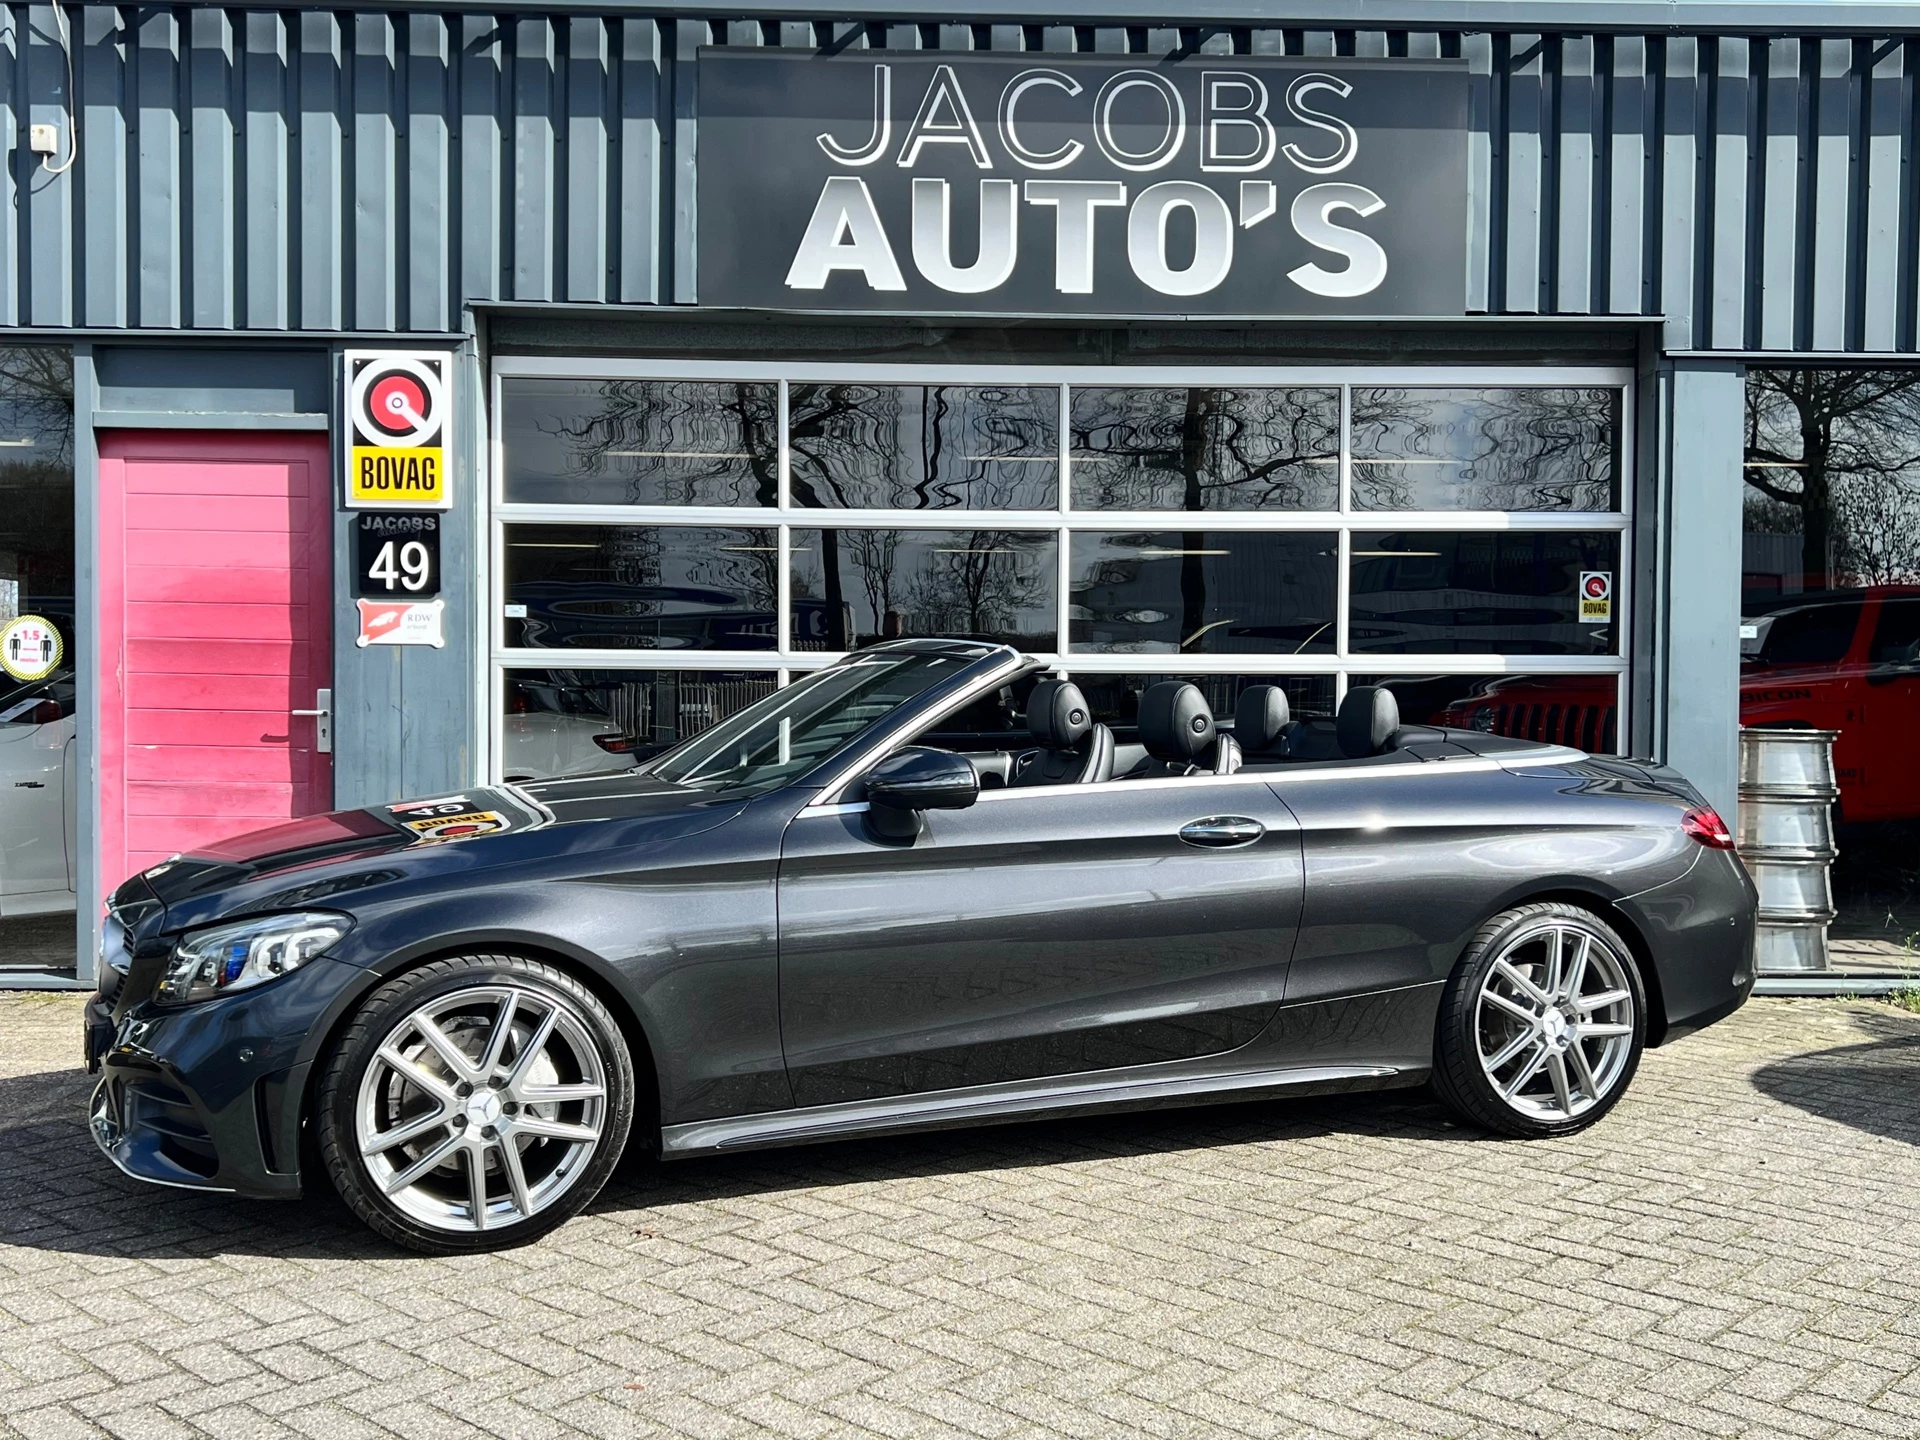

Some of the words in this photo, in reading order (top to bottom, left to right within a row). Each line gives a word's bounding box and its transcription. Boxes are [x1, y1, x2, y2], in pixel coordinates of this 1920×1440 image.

[816, 64, 1359, 175] JACOBS
[784, 175, 1388, 298] AUTO'S
[361, 456, 435, 491] BOVAG
[361, 516, 436, 531] JACOBS
[369, 541, 429, 591] 49
[407, 614, 433, 622] RDW
[1583, 602, 1607, 614] BOVAG
[22, 630, 40, 641] 1.5
